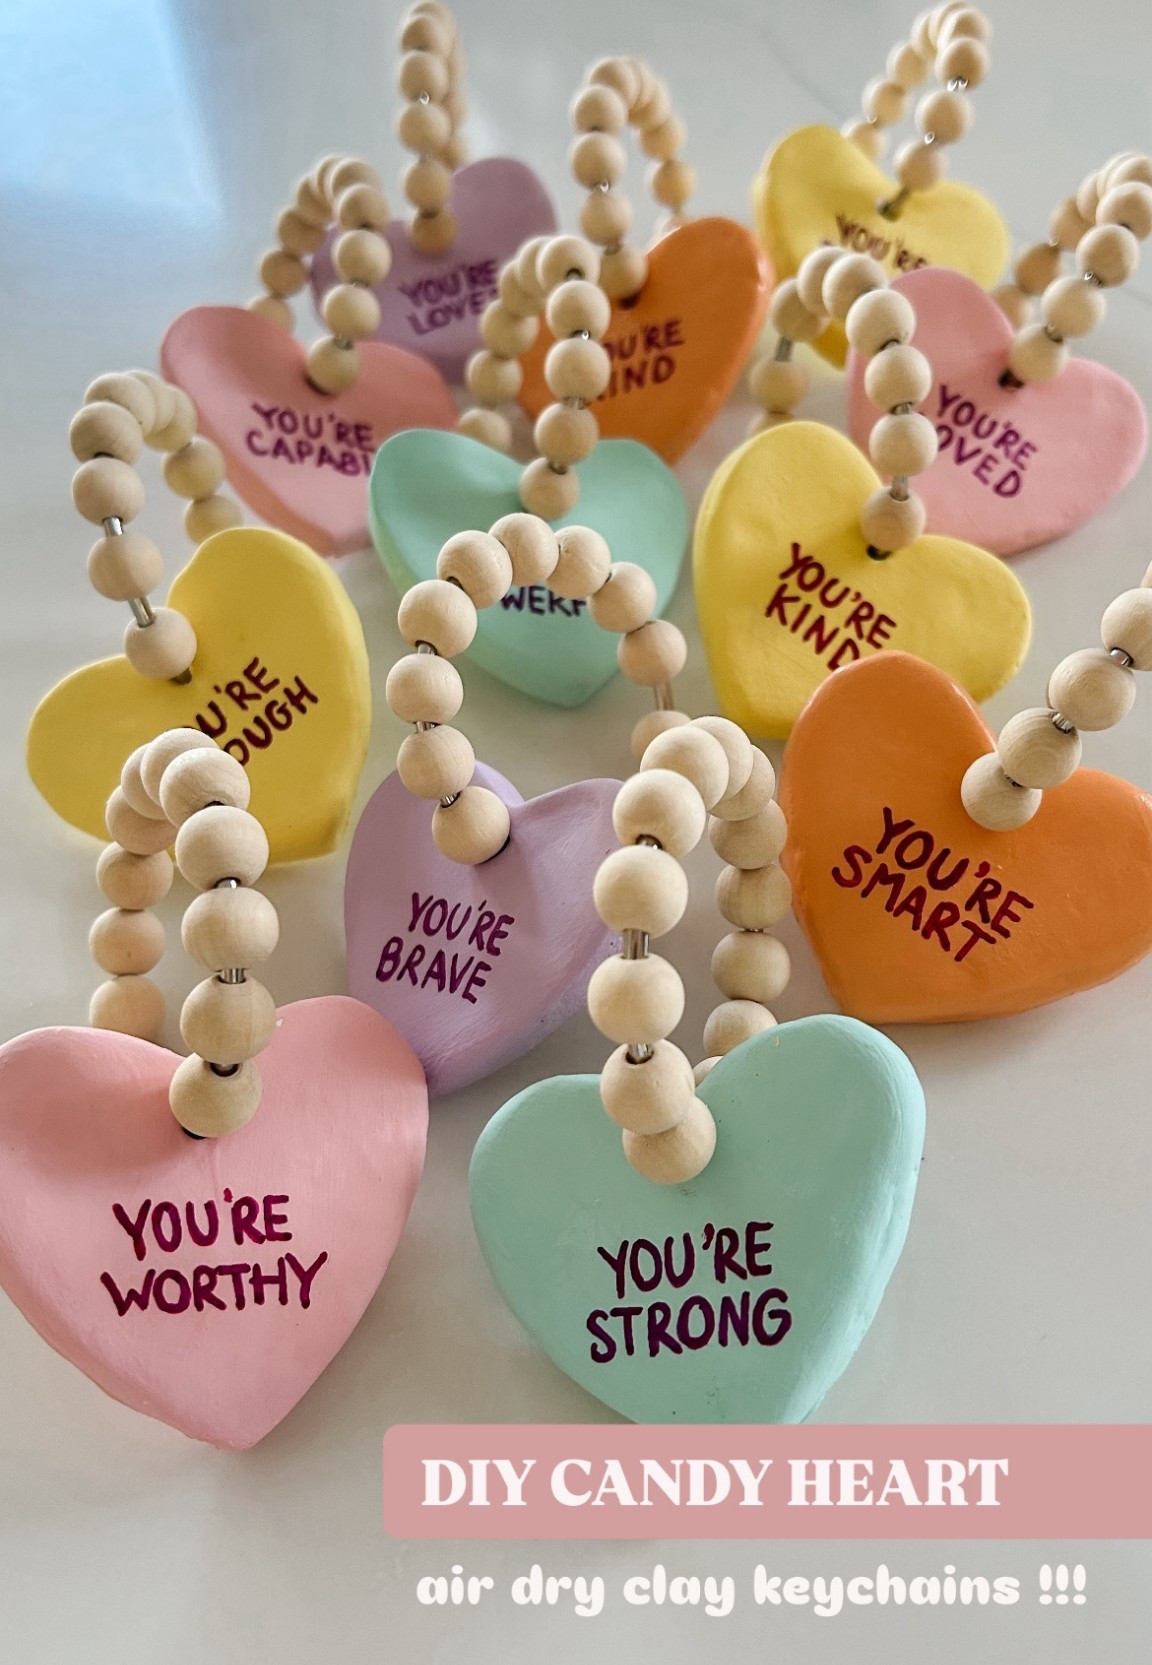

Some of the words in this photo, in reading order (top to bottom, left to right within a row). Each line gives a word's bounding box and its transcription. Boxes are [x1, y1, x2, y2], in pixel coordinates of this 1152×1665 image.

[398, 260, 497, 307] YOU'RE
[407, 288, 498, 335] LOVE
[598, 355, 675, 400] IND
[246, 430, 371, 477] CAPAB
[251, 402, 375, 453] YOU'RE
[922, 413, 1022, 498] OVED
[937, 385, 1038, 471] YOU'RE
[765, 583, 861, 671] KIND
[779, 542, 897, 649] YOU'RE
[182, 657, 280, 739] U'RE
[223, 675, 319, 767] OUGH
[831, 845, 997, 962] SMART
[876, 807, 1034, 938] YOU'RE
[408, 892, 515, 956] YOU'RE
[376, 936, 492, 1004] BRAVE
[112, 1188, 292, 1261] YOU'RE
[597, 1221, 774, 1299] YOU'RE
[100, 1251, 328, 1317] WORTHY
[587, 1288, 792, 1363] STRONG
